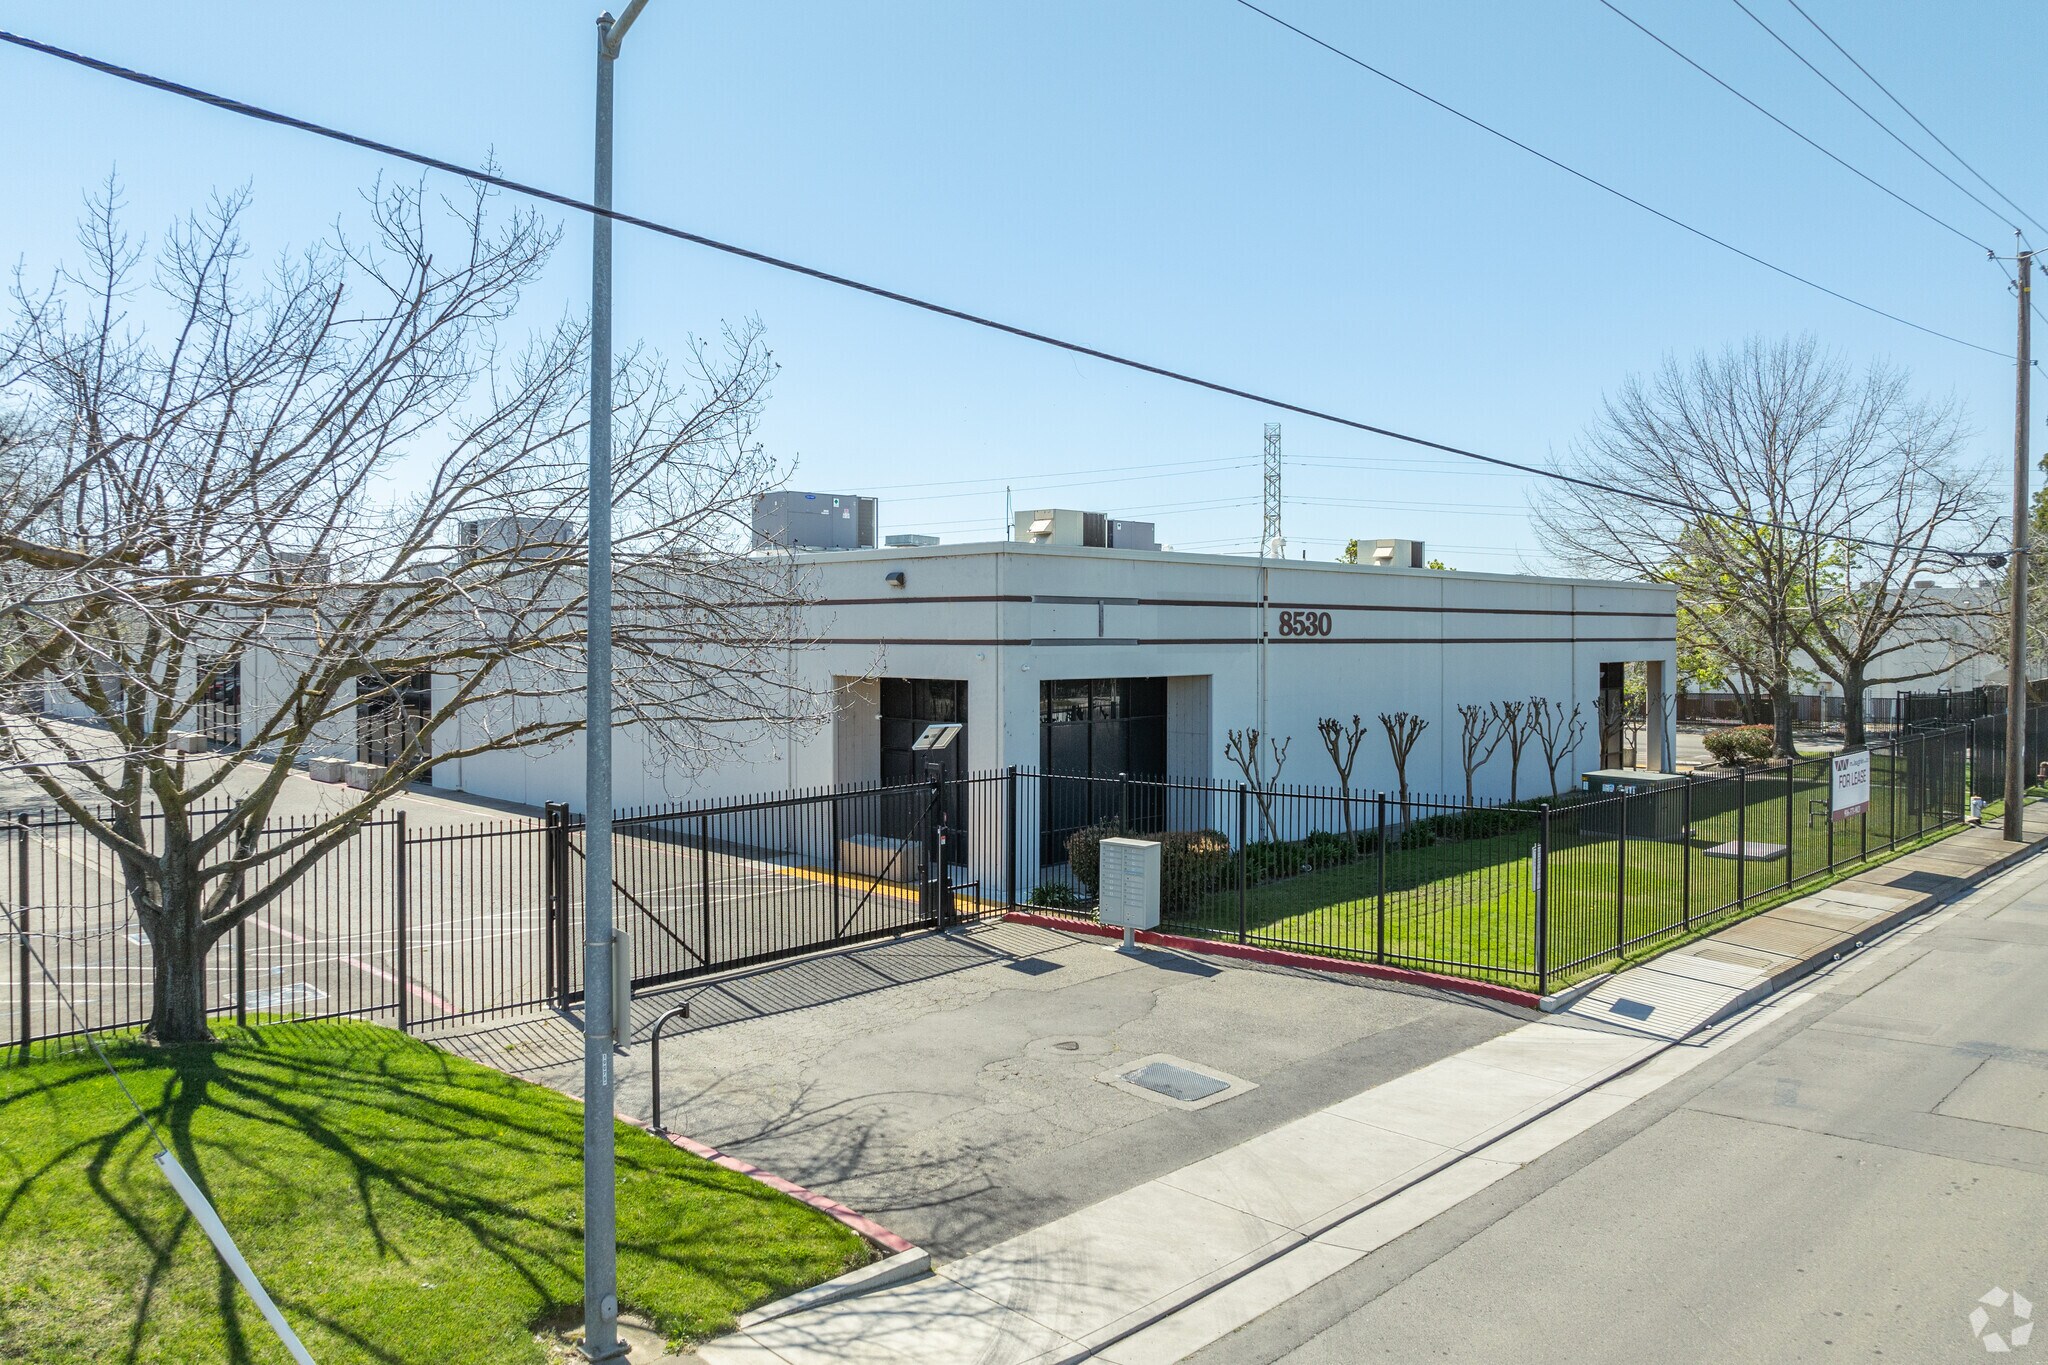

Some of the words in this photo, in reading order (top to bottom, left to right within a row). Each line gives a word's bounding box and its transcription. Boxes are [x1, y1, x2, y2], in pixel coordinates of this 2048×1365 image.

[1279, 611, 1332, 636] 8530
[1839, 773, 1850, 788] FOR
[1852, 769, 1866, 785] LEASE
